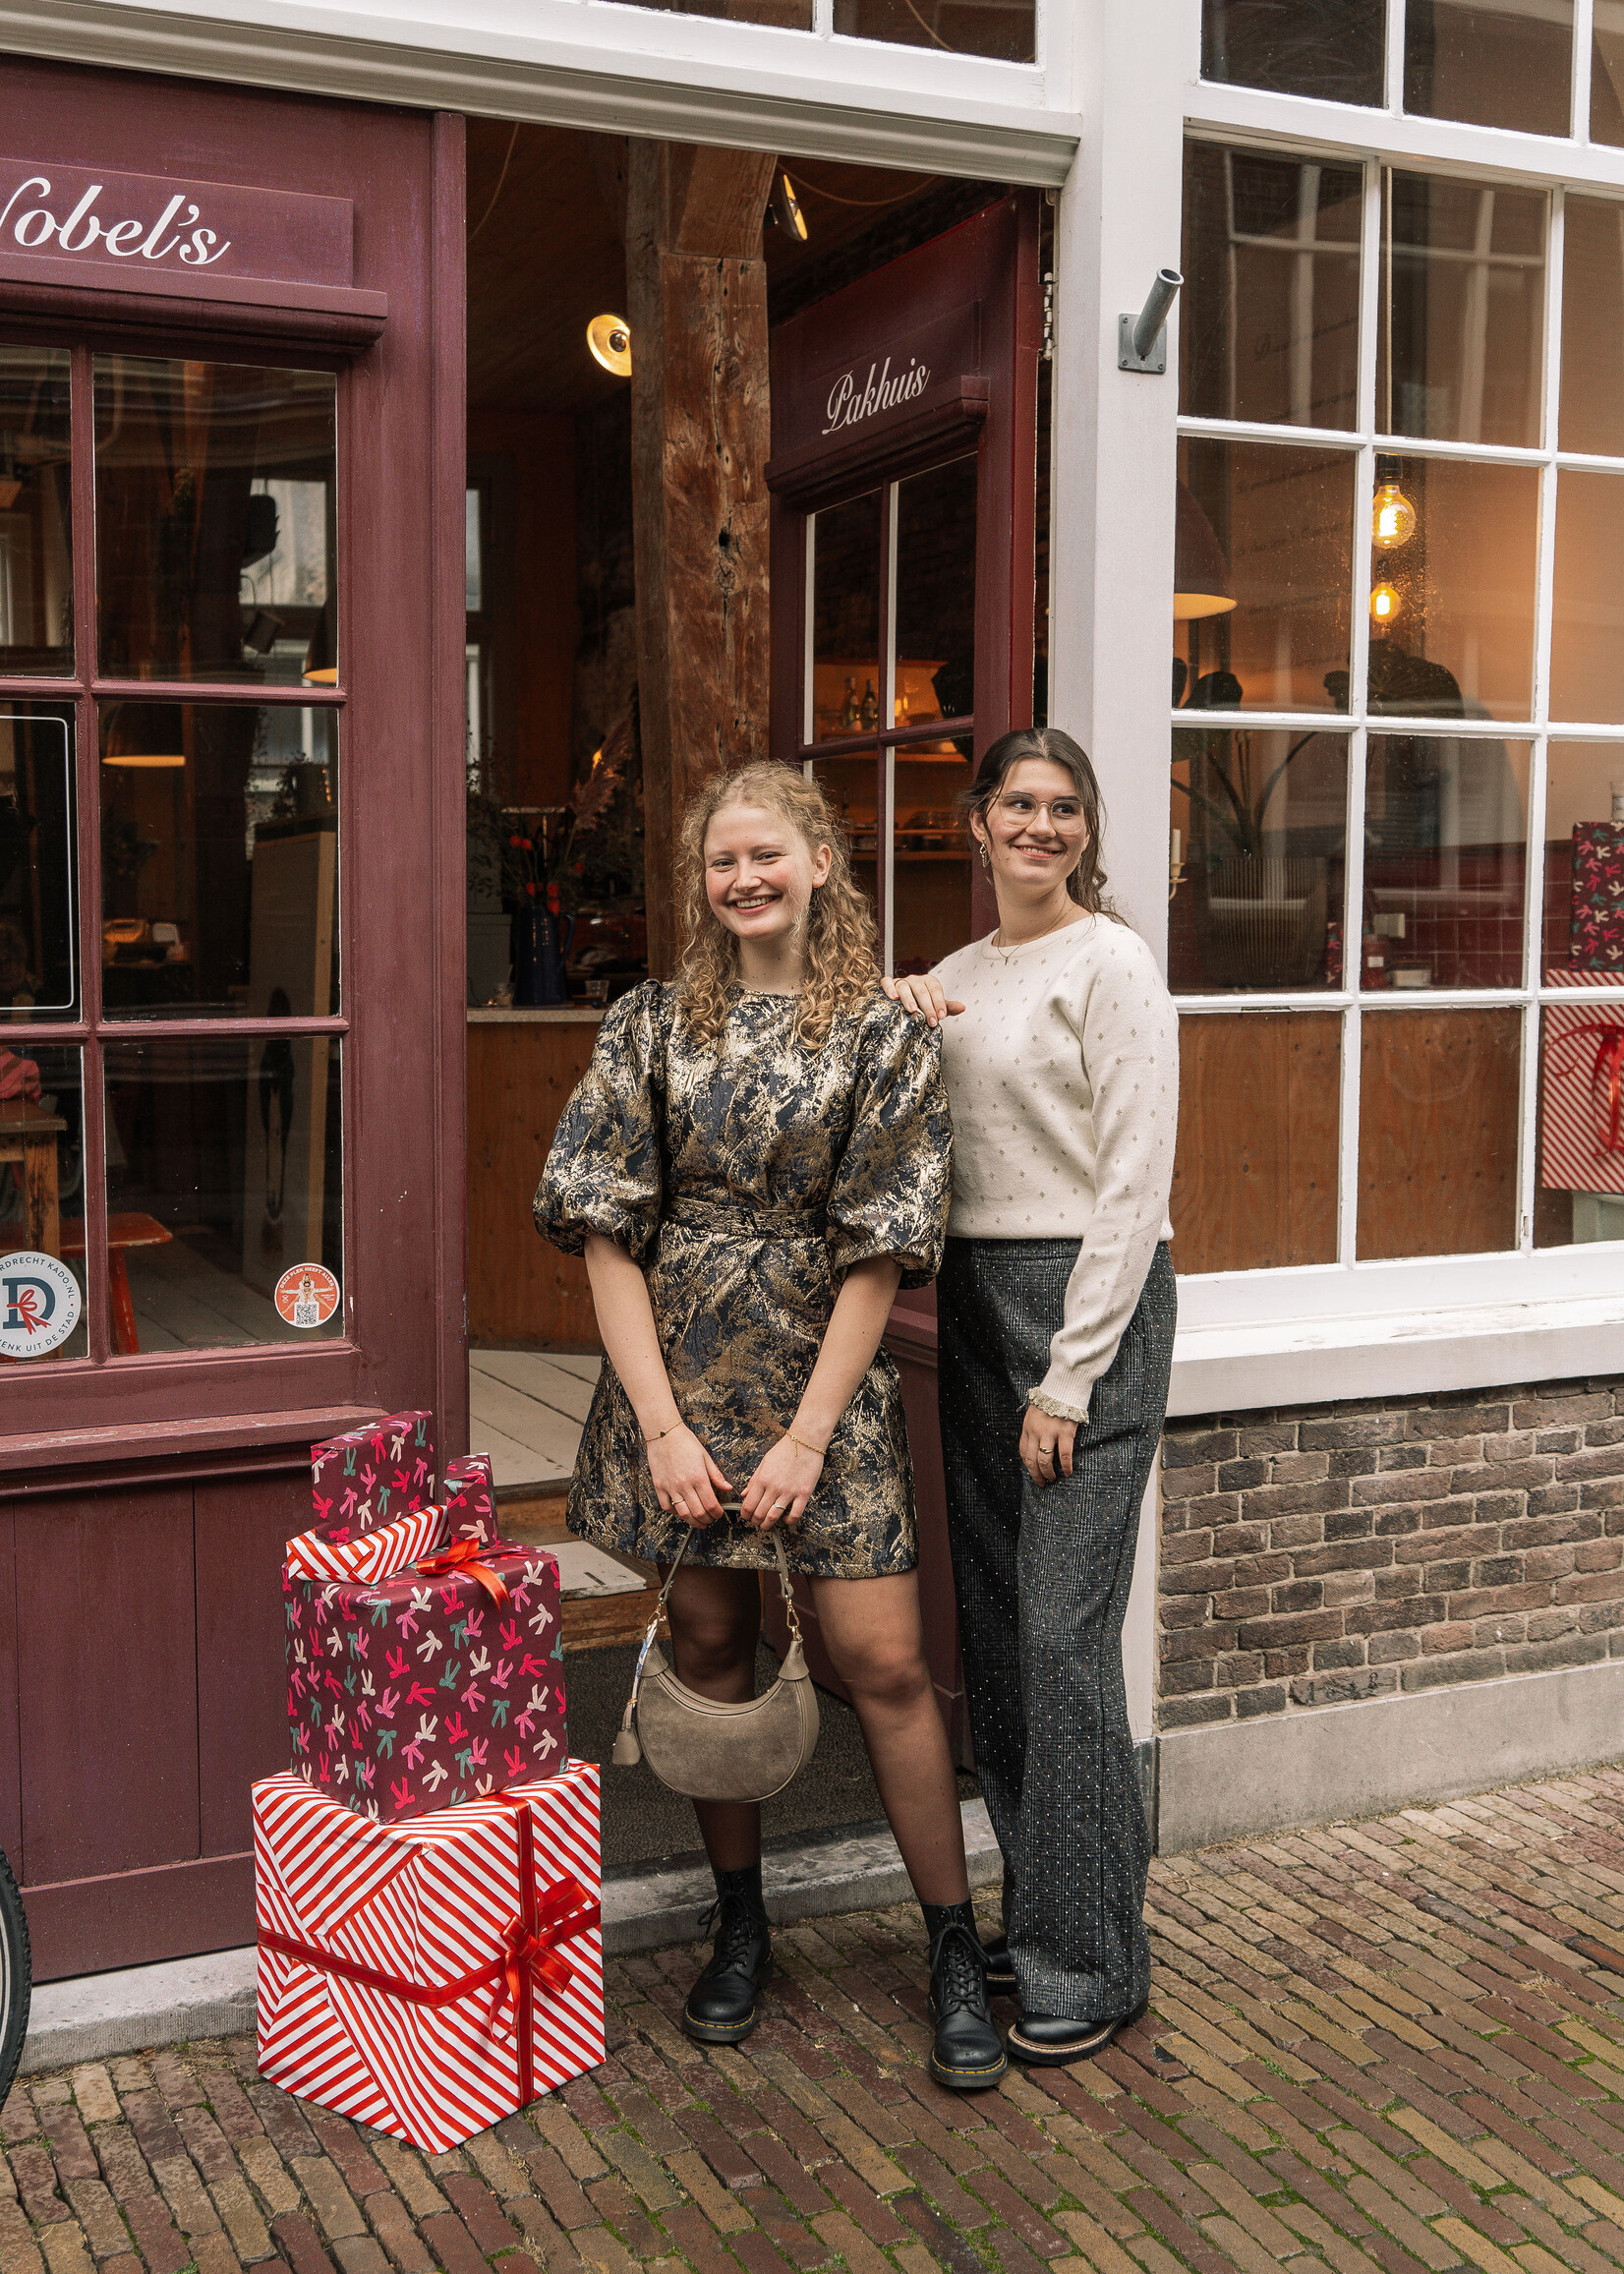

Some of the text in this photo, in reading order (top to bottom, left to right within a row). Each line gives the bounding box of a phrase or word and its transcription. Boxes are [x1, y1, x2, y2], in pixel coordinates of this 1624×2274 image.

[822, 357, 931, 435] Pakhuis
[47, 1262, 76, 1299] KADO.NL
[279, 1275, 291, 1288] DEZE
[321, 1272, 334, 1287] ALLES
[0, 1311, 75, 1352] ENK UIT DE STAD
